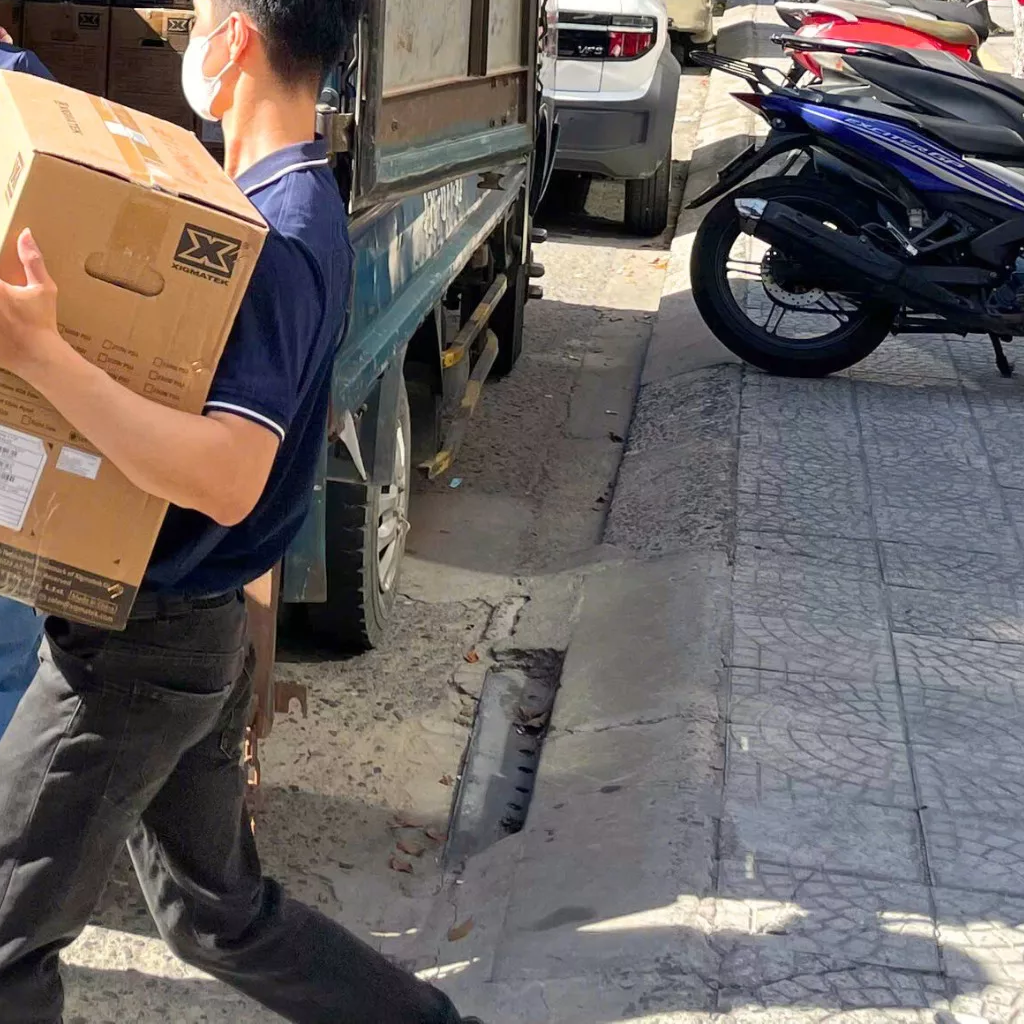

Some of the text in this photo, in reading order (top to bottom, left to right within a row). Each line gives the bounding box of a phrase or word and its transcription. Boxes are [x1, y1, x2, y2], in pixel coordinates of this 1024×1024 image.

[844, 117, 966, 169] EXCITER GP
[171, 262, 229, 286] XIGMATEK
